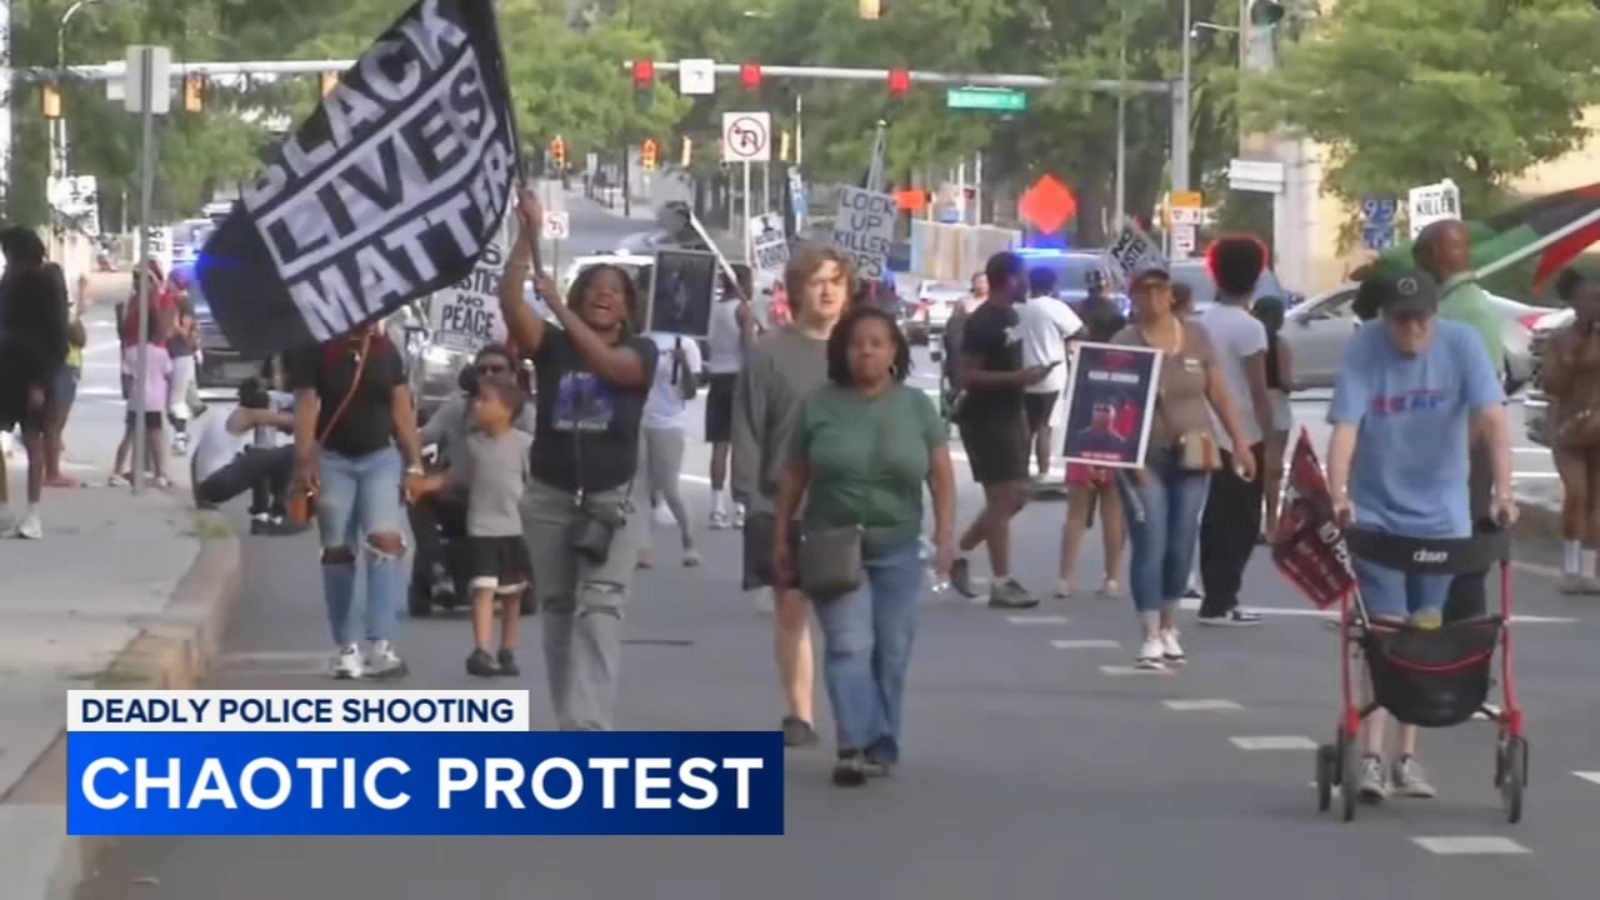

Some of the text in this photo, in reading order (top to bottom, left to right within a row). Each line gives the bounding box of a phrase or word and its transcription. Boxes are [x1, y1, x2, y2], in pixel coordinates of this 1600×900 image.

[240, 0, 468, 213] BLACK
[265, 64, 488, 266] LIVES
[841, 189, 896, 217] LOCK
[1416, 197, 1457, 215] KILLER
[850, 213, 883, 232] UP
[288, 140, 514, 342] MATTER
[833, 229, 890, 257] KILLER
[1111, 225, 1133, 258] NO
[456, 293, 485, 308] NO
[440, 303, 495, 340] PEACE
